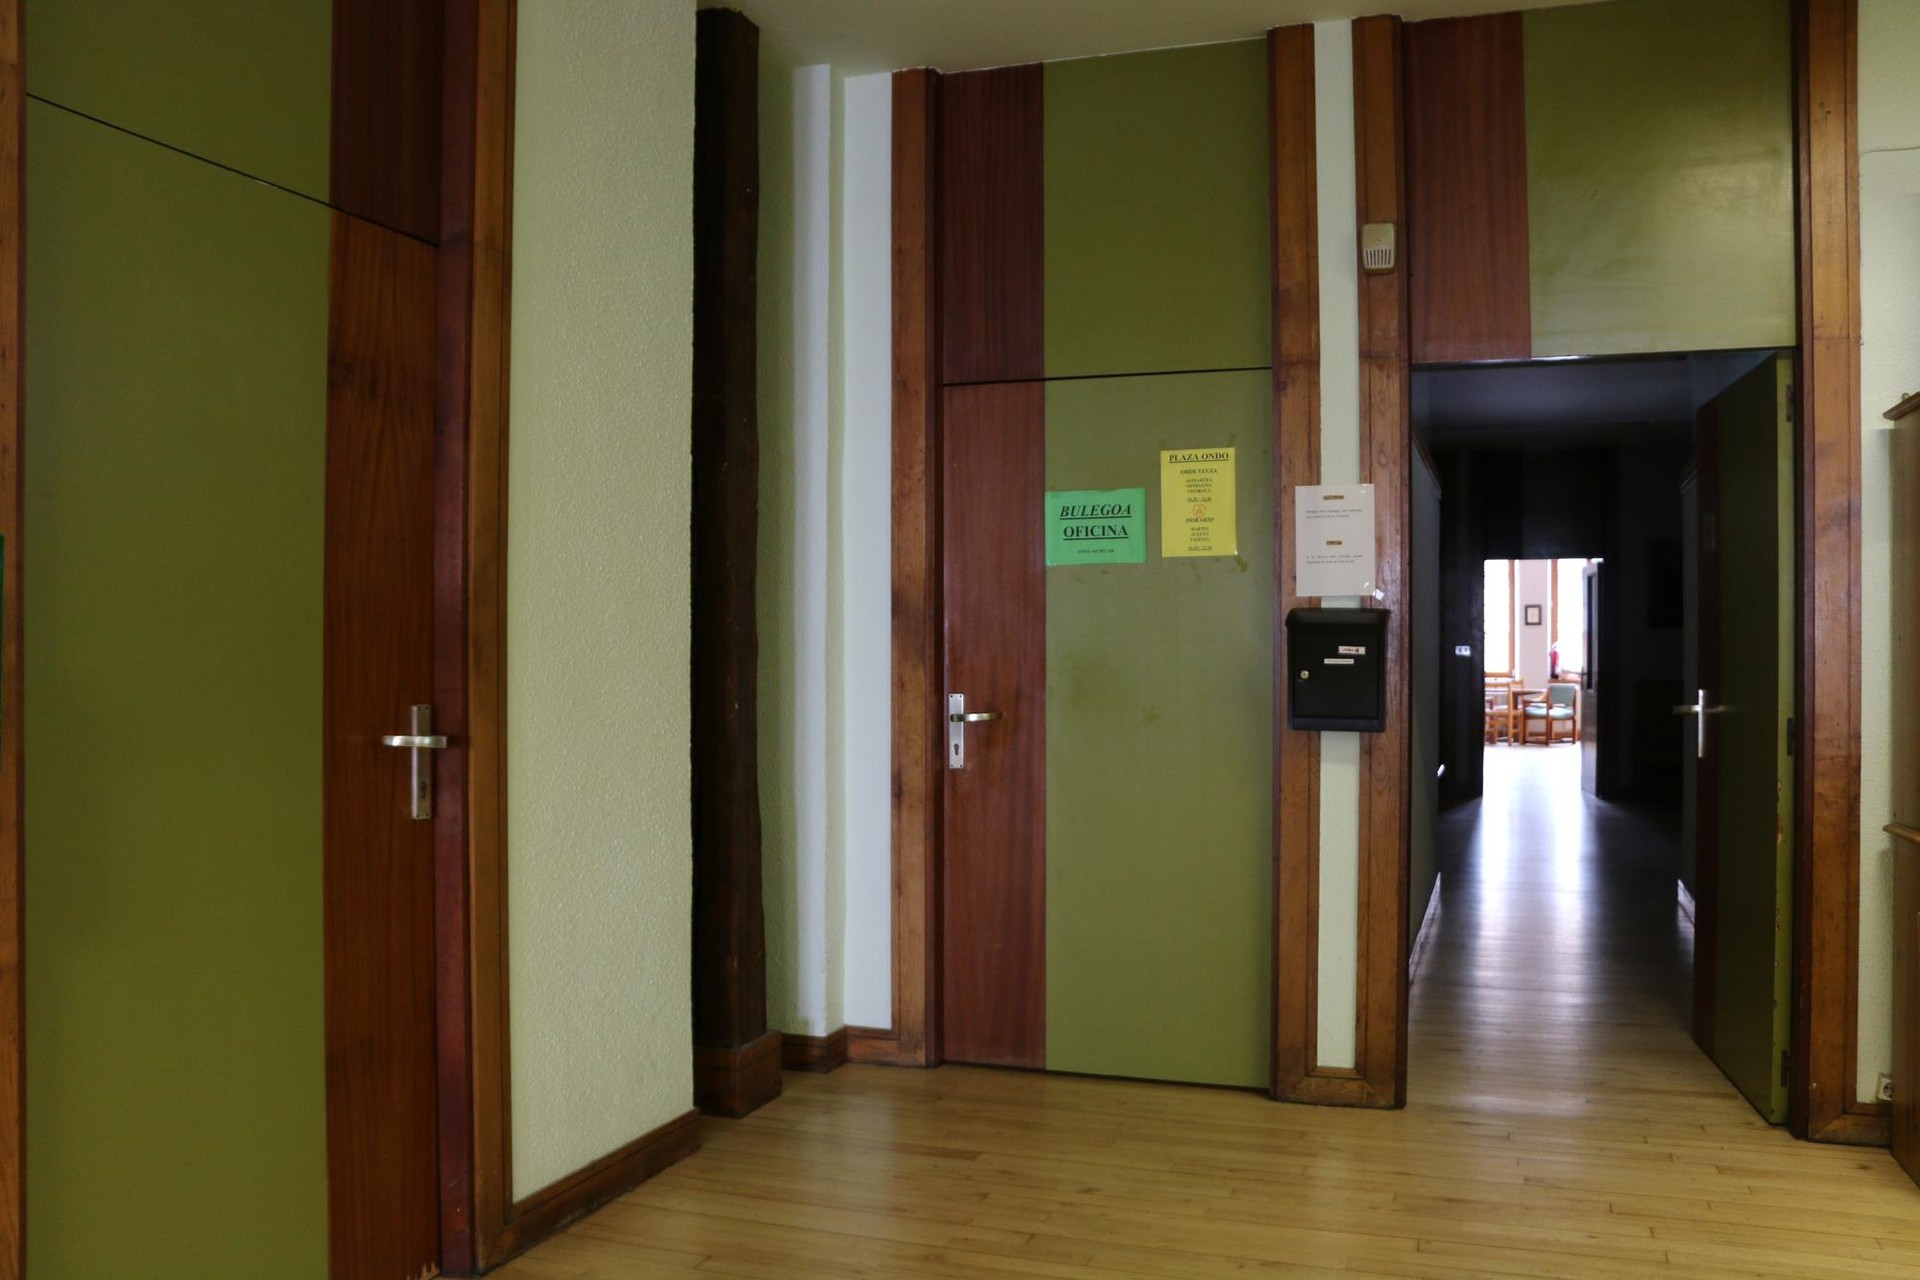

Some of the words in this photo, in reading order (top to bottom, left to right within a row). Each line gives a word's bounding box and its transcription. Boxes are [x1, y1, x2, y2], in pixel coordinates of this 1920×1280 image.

[1168, 453, 1199, 462] PLAZA
[1201, 452, 1229, 460] ONDO
[1060, 504, 1131, 517] BULEGOA
[1063, 525, 1129, 537] OFICINA
